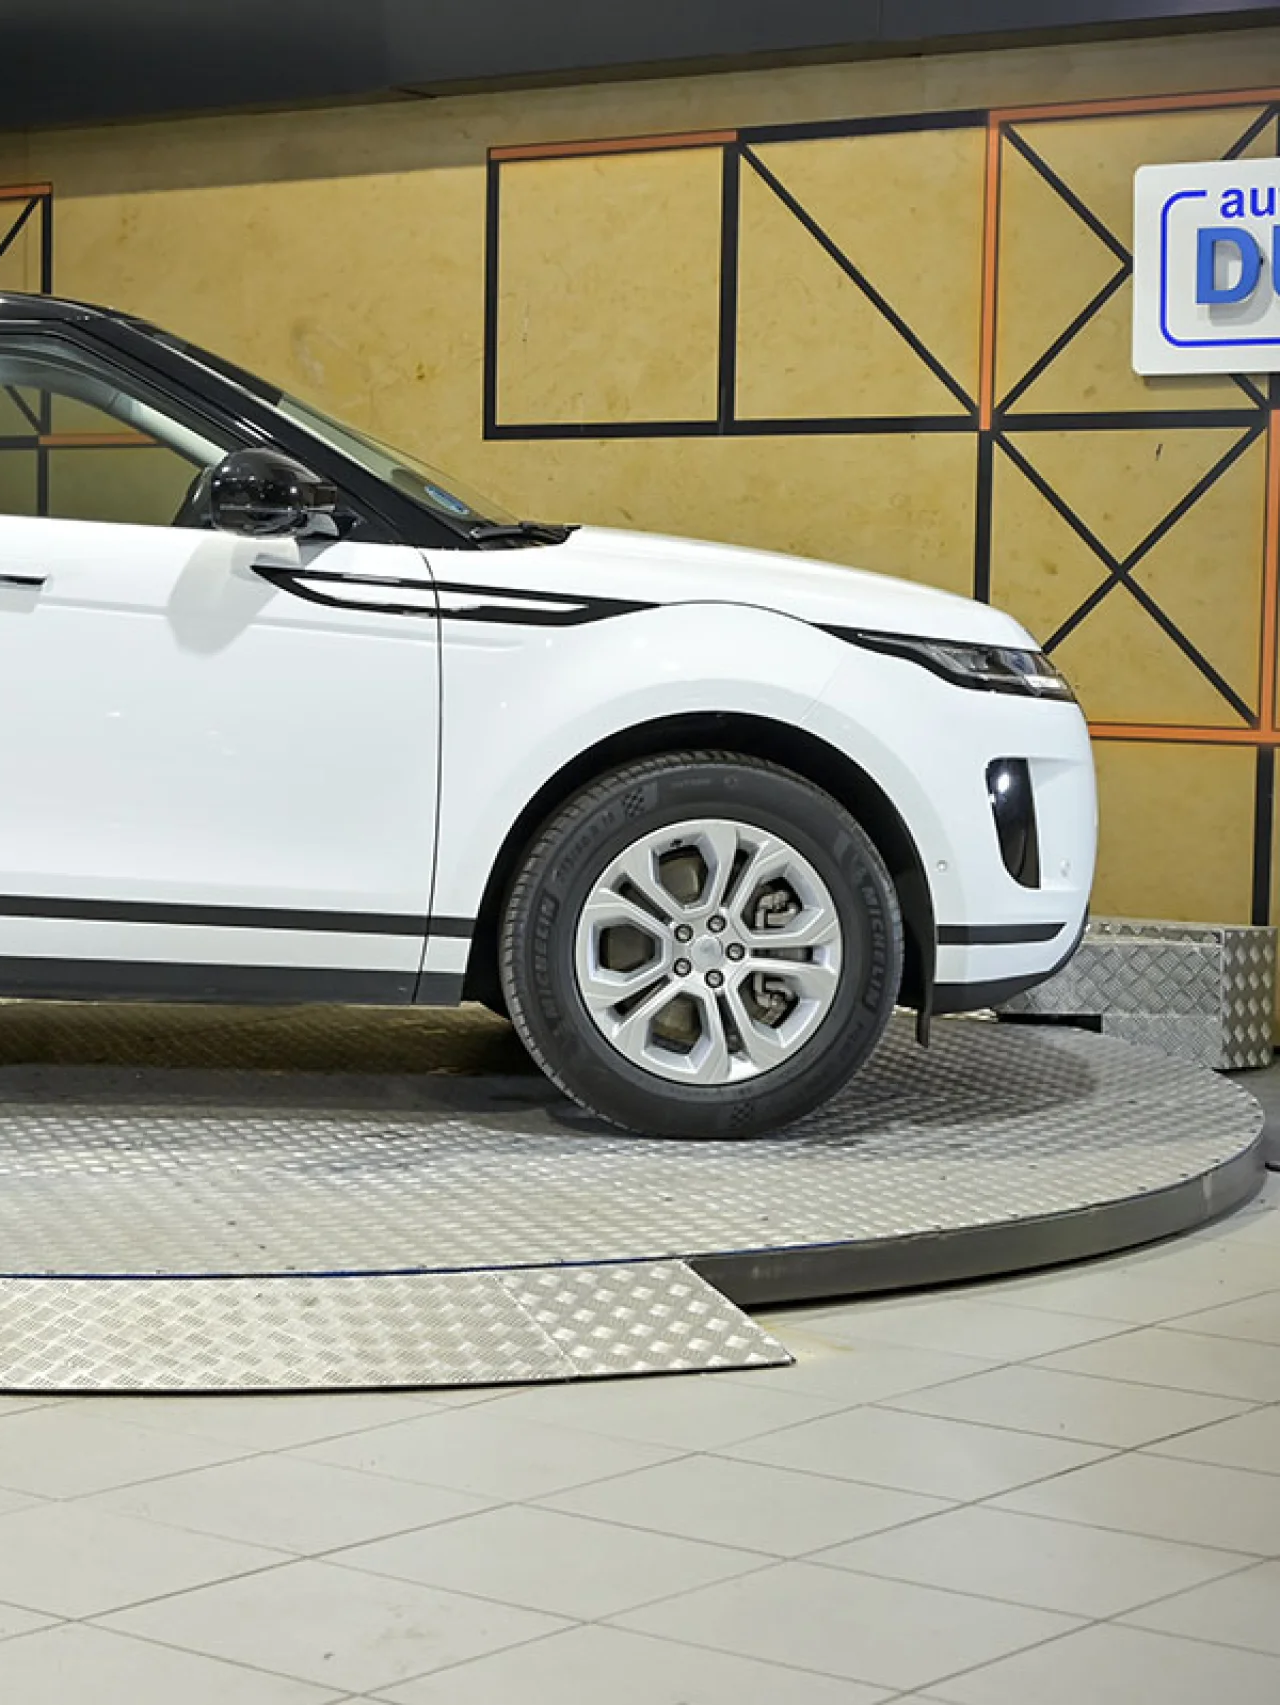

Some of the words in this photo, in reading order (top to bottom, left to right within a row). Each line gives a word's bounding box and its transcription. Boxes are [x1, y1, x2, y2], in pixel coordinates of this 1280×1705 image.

[1220, 187, 1280, 218] au
[1196, 224, 1280, 305] D
[861, 885, 886, 1007] MICHELIN
